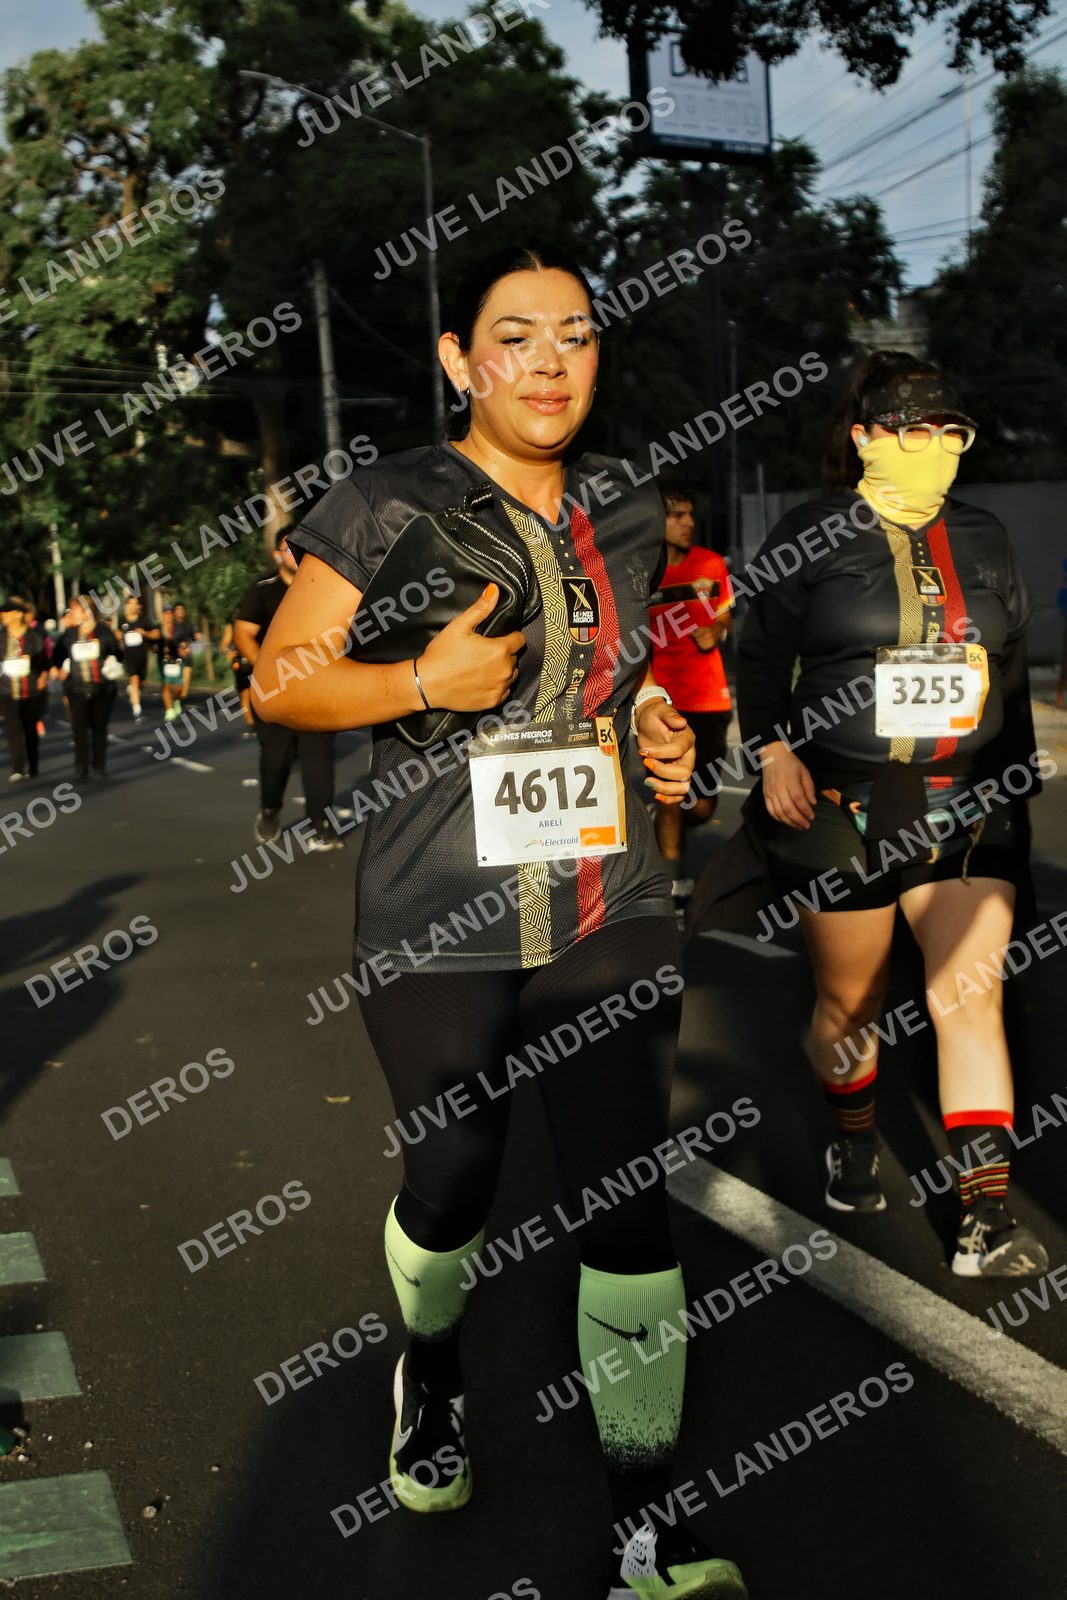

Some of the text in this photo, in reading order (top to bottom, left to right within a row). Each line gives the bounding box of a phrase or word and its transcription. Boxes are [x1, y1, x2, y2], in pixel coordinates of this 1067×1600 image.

[892, 675, 965, 705] 3255
[520, 730, 553, 740] NEGROS
[494, 764, 598, 815] 4612
[544, 836, 580, 847] Electrolit
